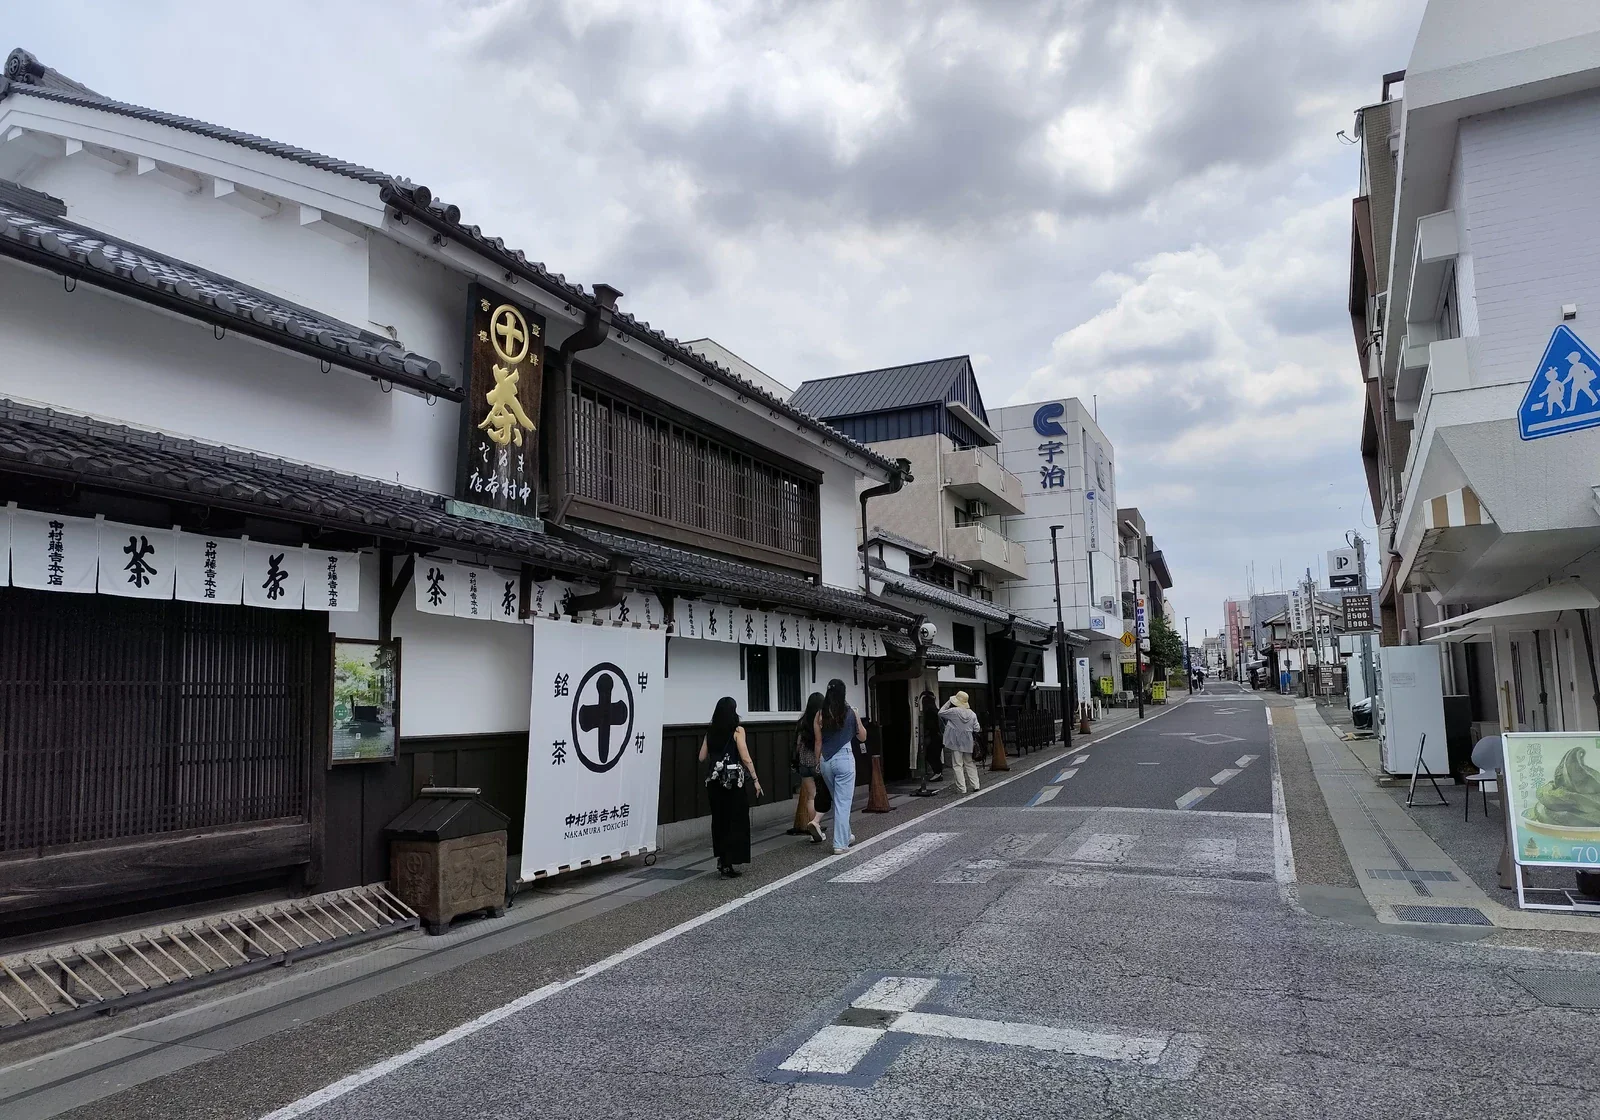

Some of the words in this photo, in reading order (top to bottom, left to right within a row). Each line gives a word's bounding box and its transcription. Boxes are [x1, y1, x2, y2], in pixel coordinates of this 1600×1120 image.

[477, 364, 536, 447] 茶
[1038, 440, 1066, 489] 宇治
[47, 520, 64, 586] 中村藤吉本店
[123, 536, 157, 588] 茶
[204, 541, 217, 599] 中村藤吉本店
[262, 553, 289, 600] 茶
[328, 556, 338, 607] 中村藤吉本店
[427, 567, 447, 606] 茶
[501, 580, 516, 616] 茶
[563, 825, 601, 840] NAKAMURA
[603, 819, 629, 833] TOKICHI
[564, 803, 630, 828] 中村藤吉本店
